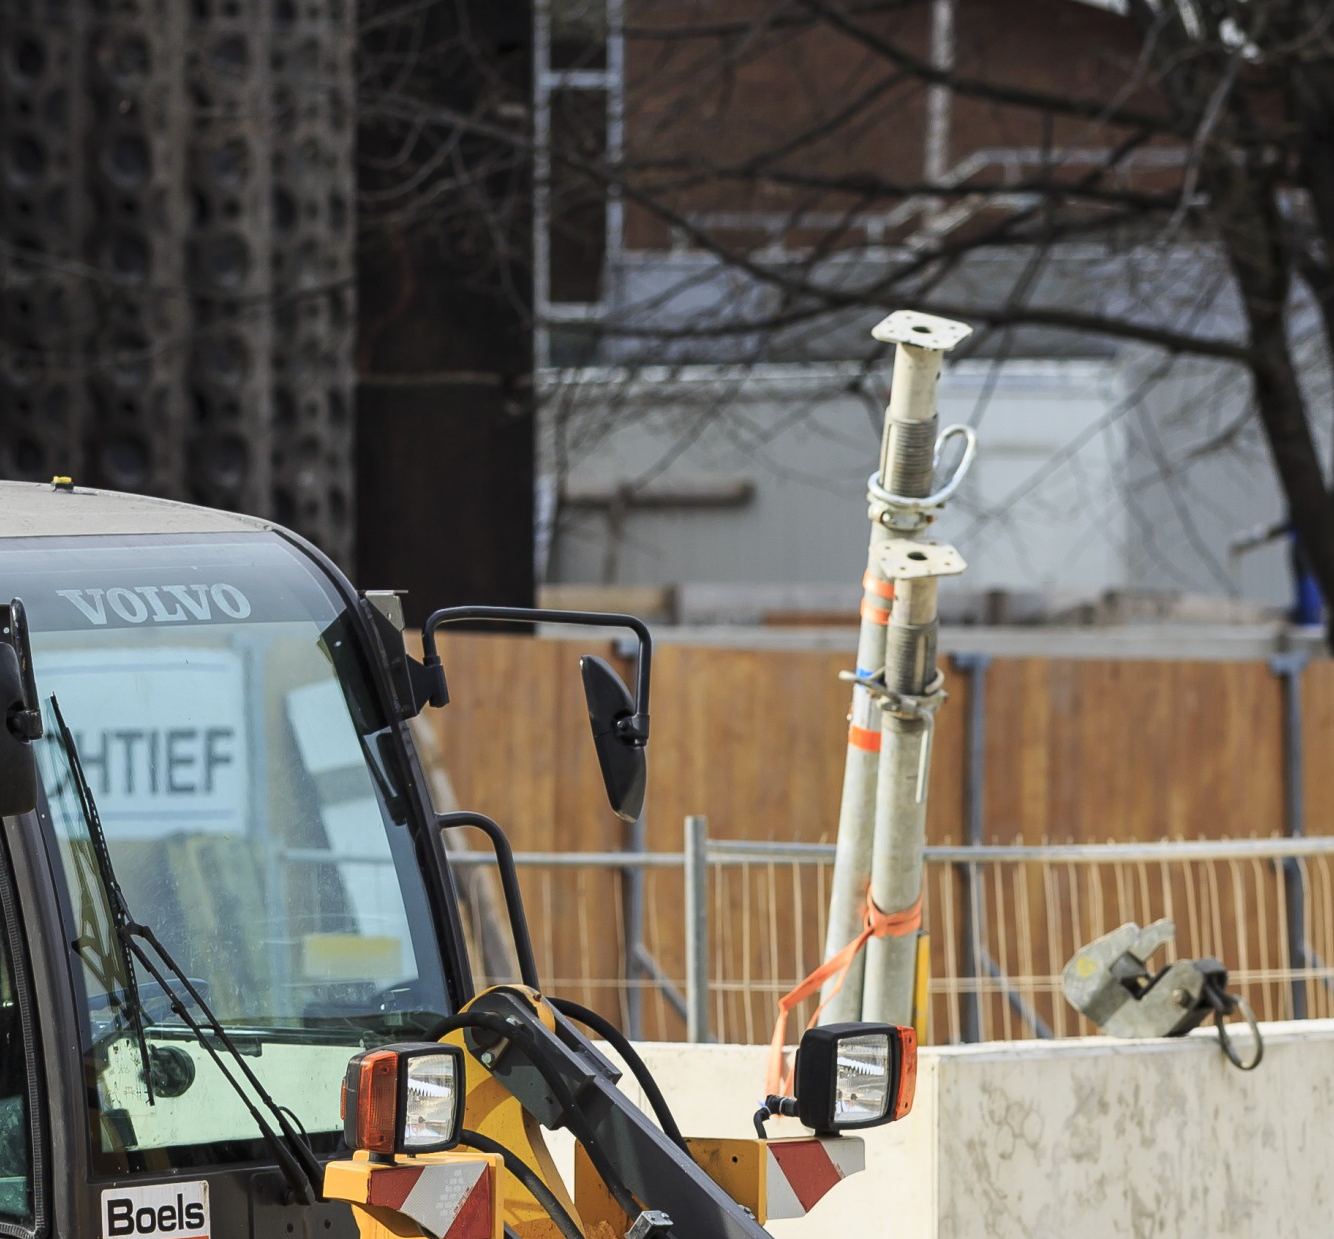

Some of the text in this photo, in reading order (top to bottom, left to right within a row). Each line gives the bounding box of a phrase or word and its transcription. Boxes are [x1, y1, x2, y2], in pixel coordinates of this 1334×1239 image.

[55, 583, 251, 625] VOLVO
[47, 727, 235, 796] HTIEF
[107, 1193, 205, 1236] Boels
